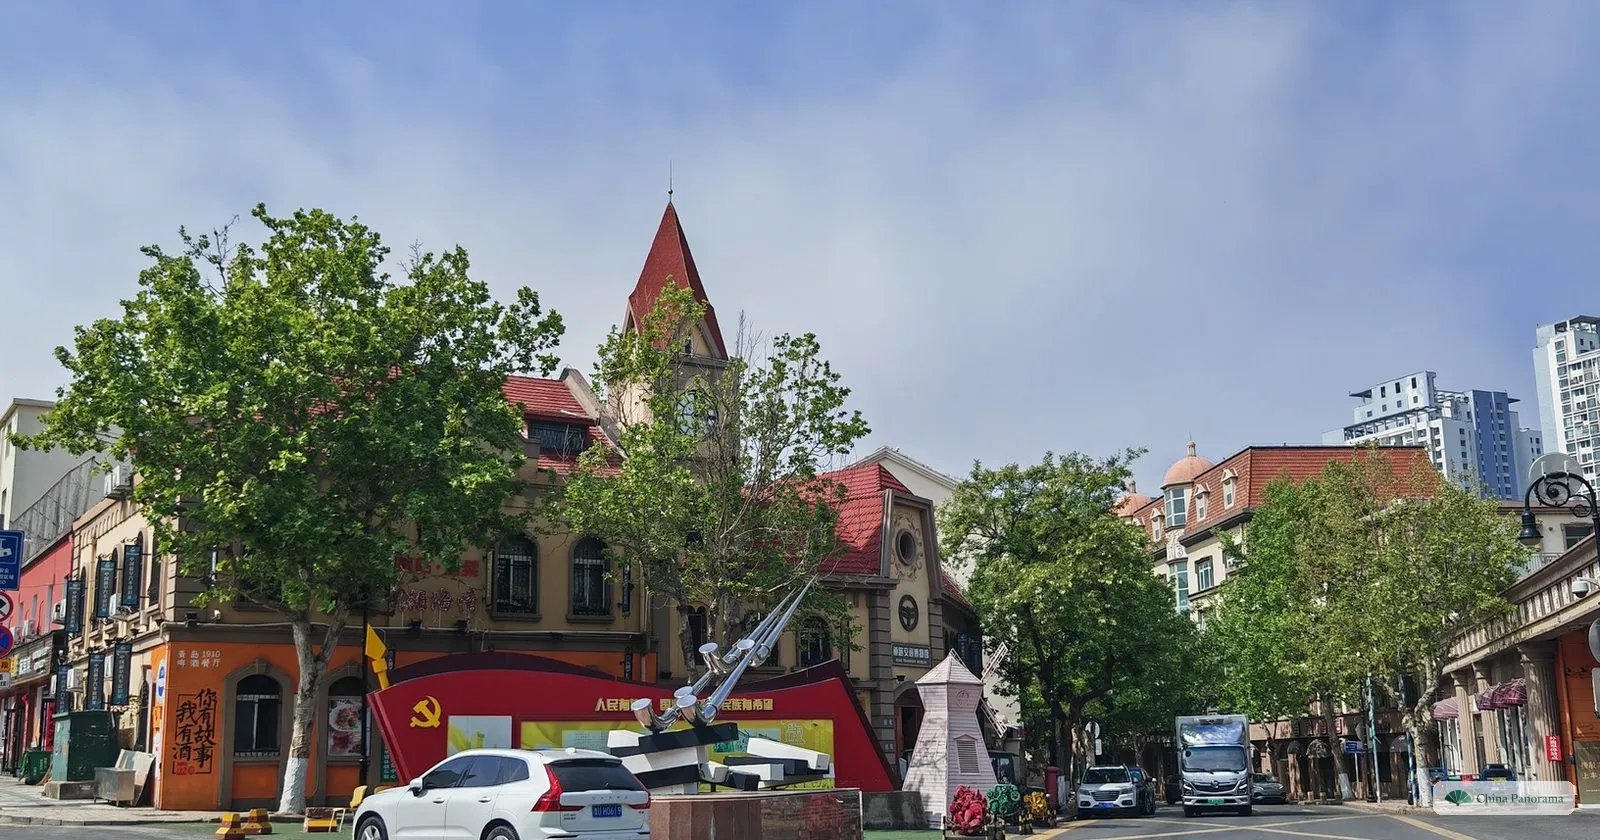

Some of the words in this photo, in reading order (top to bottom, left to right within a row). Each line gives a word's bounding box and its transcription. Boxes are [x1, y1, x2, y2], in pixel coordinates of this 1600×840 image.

[202, 650, 221, 659] 1910
[721, 698, 773, 711] 民族有希望
[172, 700, 198, 762] 我有酒
[194, 688, 218, 768] 你有故事
